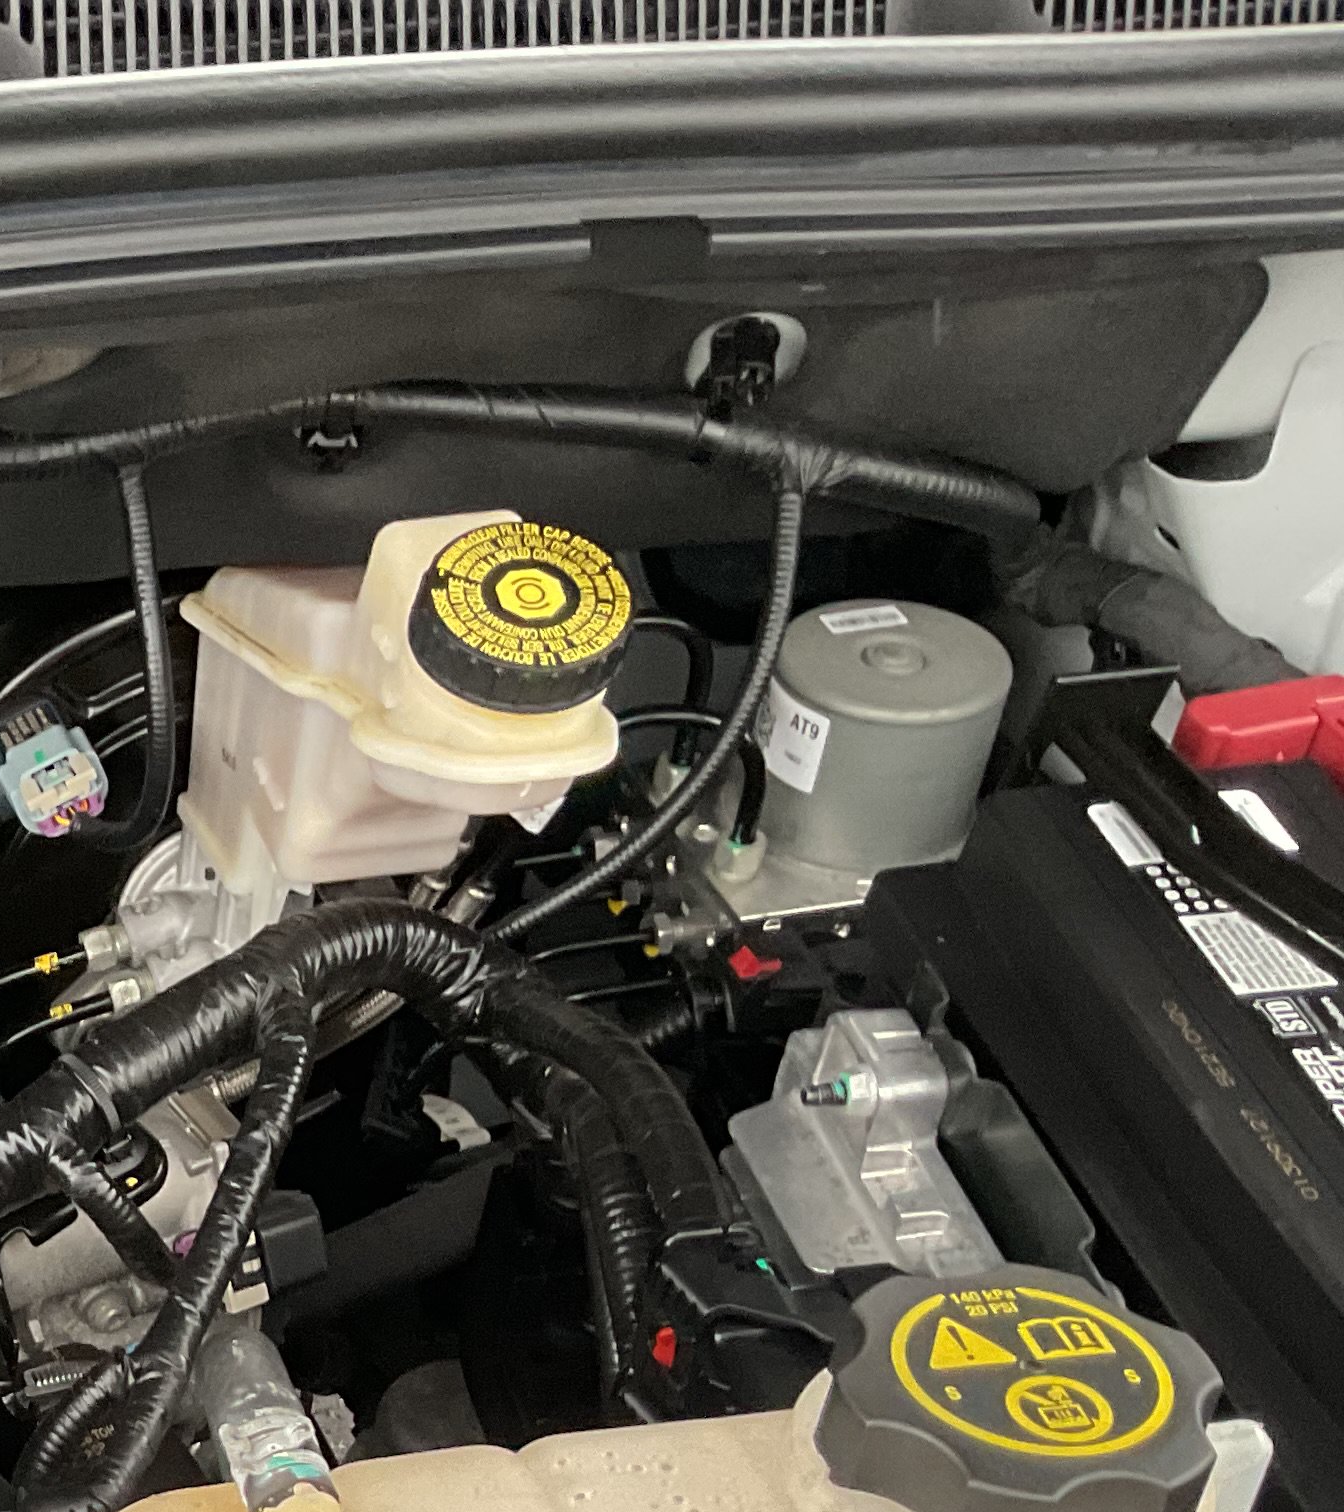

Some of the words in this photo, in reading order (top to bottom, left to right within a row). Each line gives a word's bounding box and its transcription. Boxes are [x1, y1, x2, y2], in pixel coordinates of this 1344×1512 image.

[496, 522, 540, 536] FILLER
[541, 524, 572, 543] CAP
[460, 631, 484, 649] DE
[478, 641, 535, 665] BOUCHON
[538, 653, 557, 665] LE
[790, 713, 819, 741] AT9
[1265, 1000, 1309, 1033] STD
[949, 1290, 981, 1304] 140
[981, 1288, 1016, 1301] kPa
[964, 1304, 988, 1317] 20
[988, 1301, 1019, 1314] PSI
